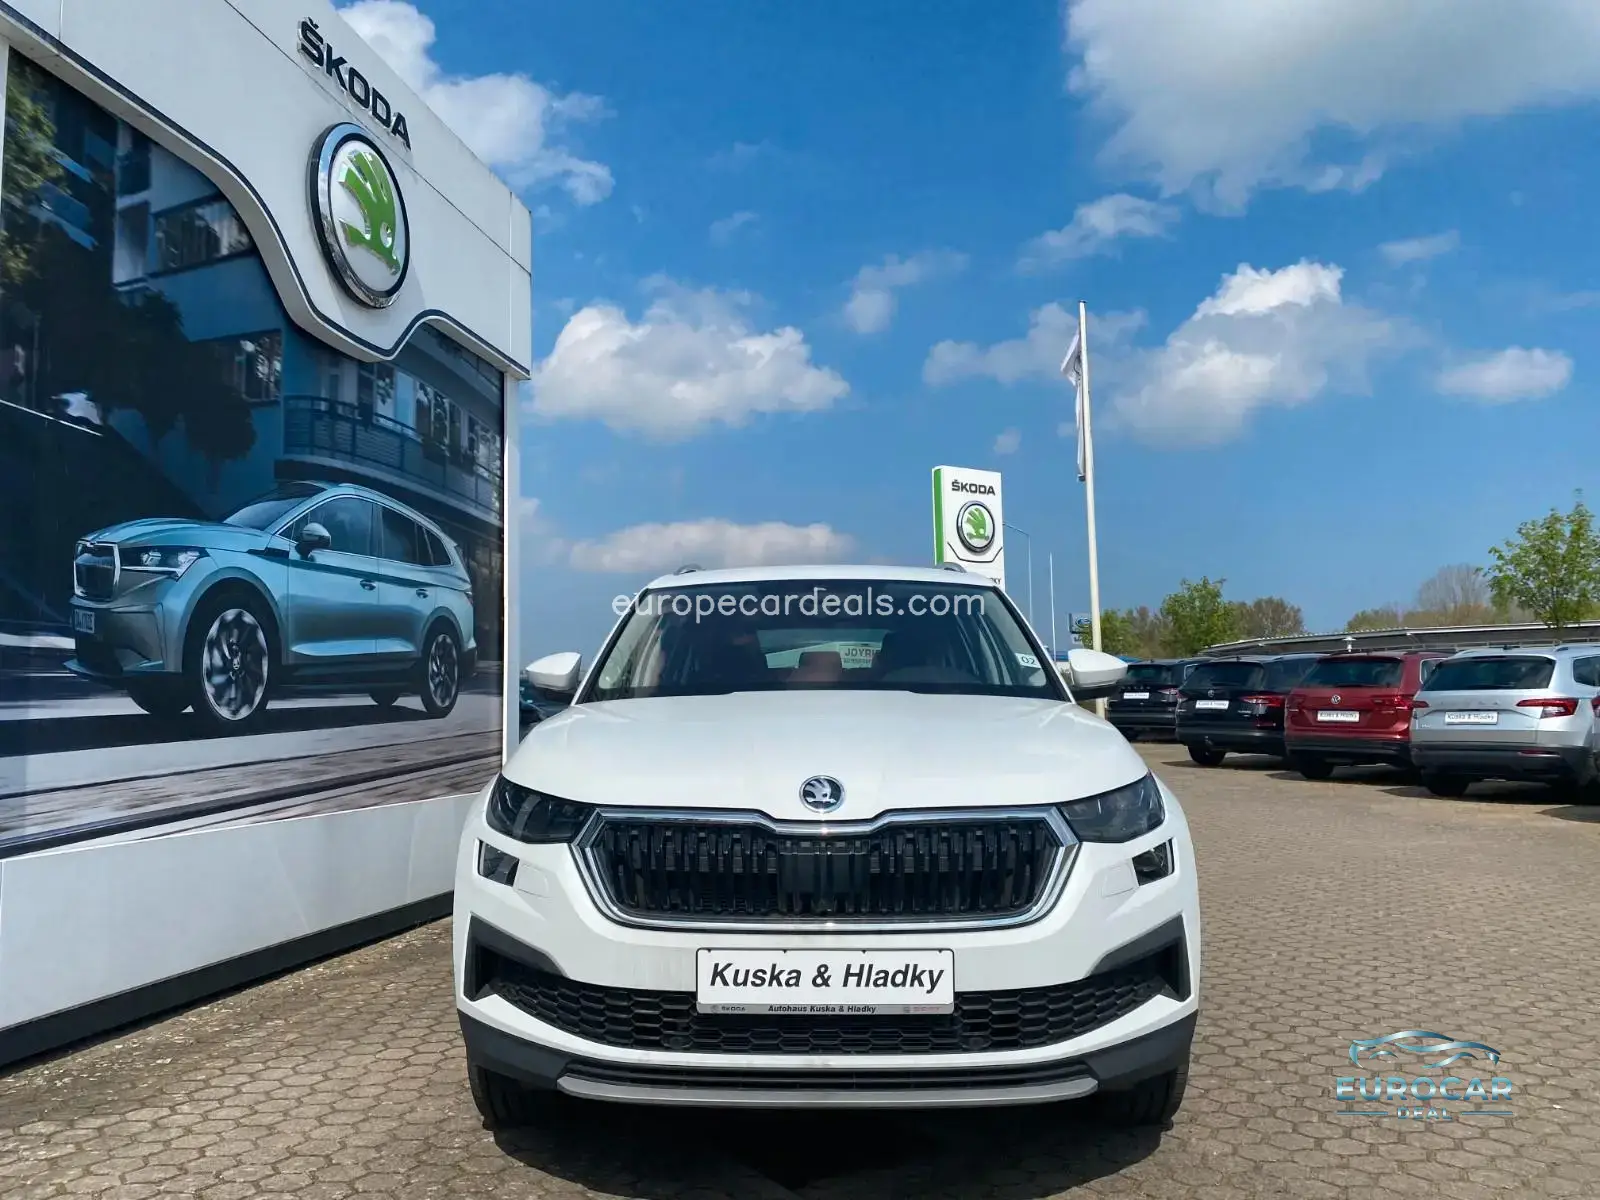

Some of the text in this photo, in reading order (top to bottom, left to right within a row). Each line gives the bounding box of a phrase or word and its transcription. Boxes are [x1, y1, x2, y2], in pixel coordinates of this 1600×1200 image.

[298, 17, 411, 151] ŠKODA
[951, 479, 996, 496] ŠKODA
[710, 963, 945, 994] Kuska & Hladky
[809, 1005, 836, 1013] Kuska
[838, 1005, 845, 1013] &
[847, 1005, 877, 1014] Hladky
